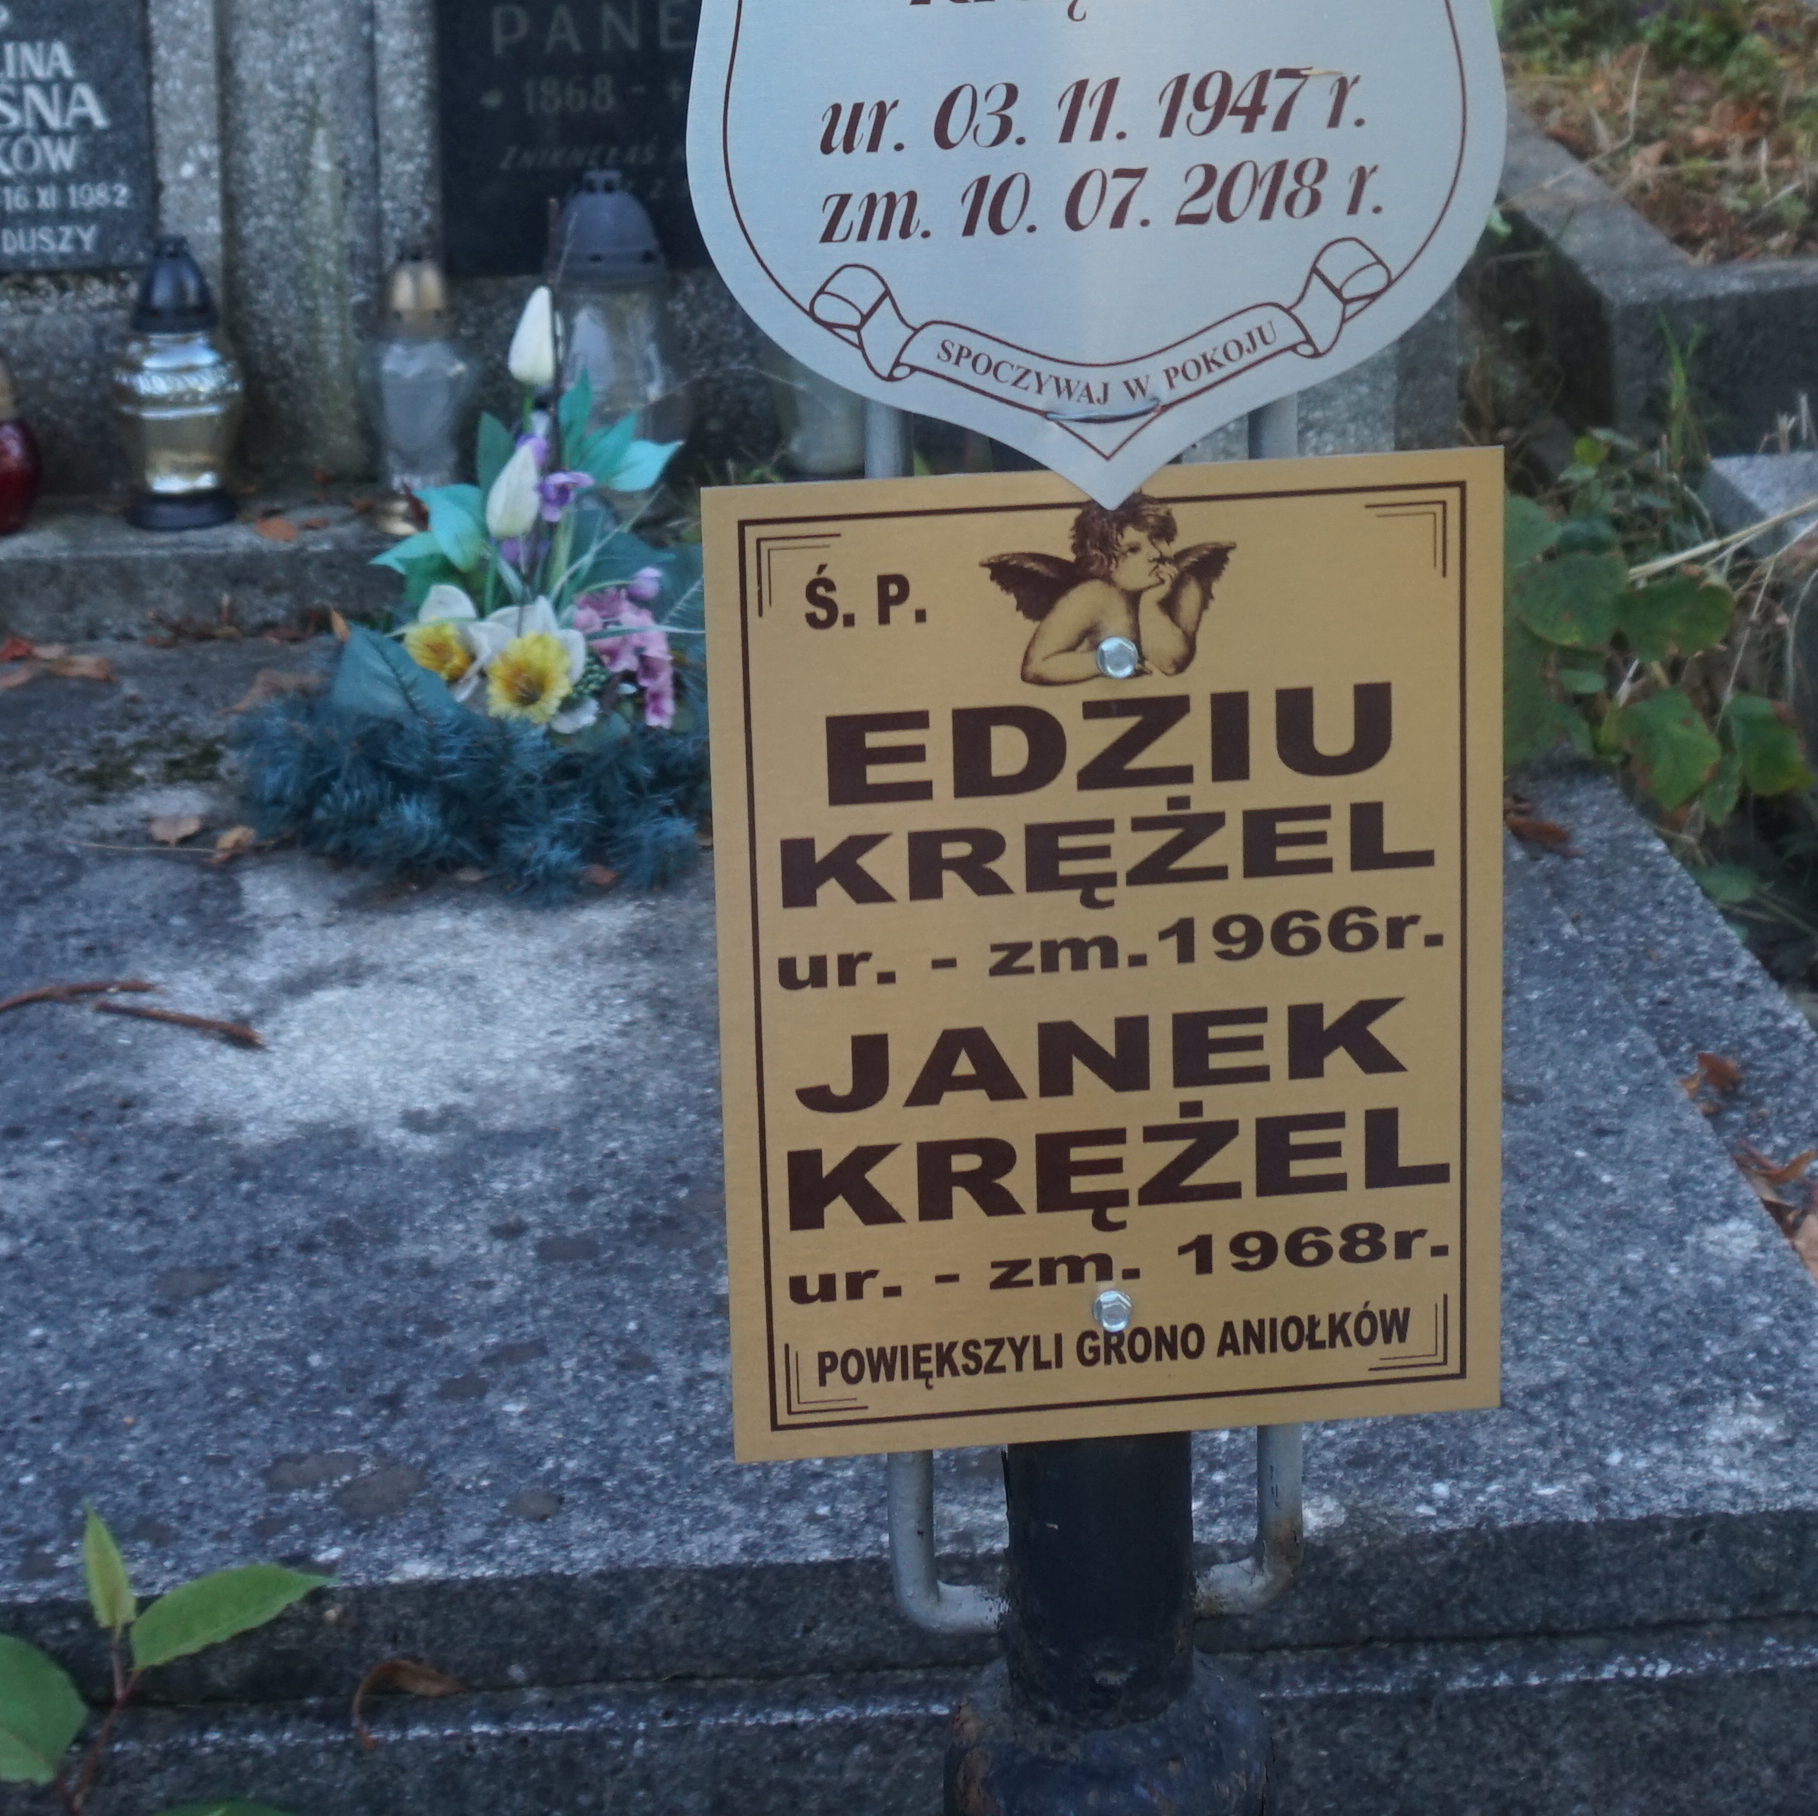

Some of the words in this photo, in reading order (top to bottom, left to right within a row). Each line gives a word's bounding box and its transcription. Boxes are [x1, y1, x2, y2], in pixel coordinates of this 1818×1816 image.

[523, 72, 616, 116] 1868
[819, 97, 904, 155] ur.
[933, 82, 1026, 150] 03.
[1057, 76, 1128, 144] 11.
[68, 183, 131, 210] 1982
[819, 188, 932, 244] zm.
[961, 171, 1038, 238] 10.
[1063, 166, 1151, 233] 07.
[1174, 157, 1329, 226] 2018
[1346, 162, 1384, 216] r.
[2, 223, 99, 256] DUSZY
[936, 338, 1110, 406] SPOCZYWAJ
[1123, 373, 1152, 402] W
[1163, 320, 1278, 390] POKOJU
[804, 563, 856, 630] Ś.
[876, 572, 928, 627] P.
[825, 681, 1393, 806] EDZIU
[780, 795, 1436, 910] KRĘŻEL
[777, 949, 898, 991] ur.
[794, 995, 1409, 1114] JANEK
[786, 1099, 1452, 1232] KRĘŻEL
[787, 1266, 902, 1305] ur.
[989, 1250, 1141, 1291] zm.
[1177, 1221, 1450, 1276] 1968r.
[817, 1331, 1064, 1390] POWIĘKSZYLI
[1075, 1321, 1206, 1368] GRONO
[1216, 1300, 1411, 1358] ANIOŁKÓW
